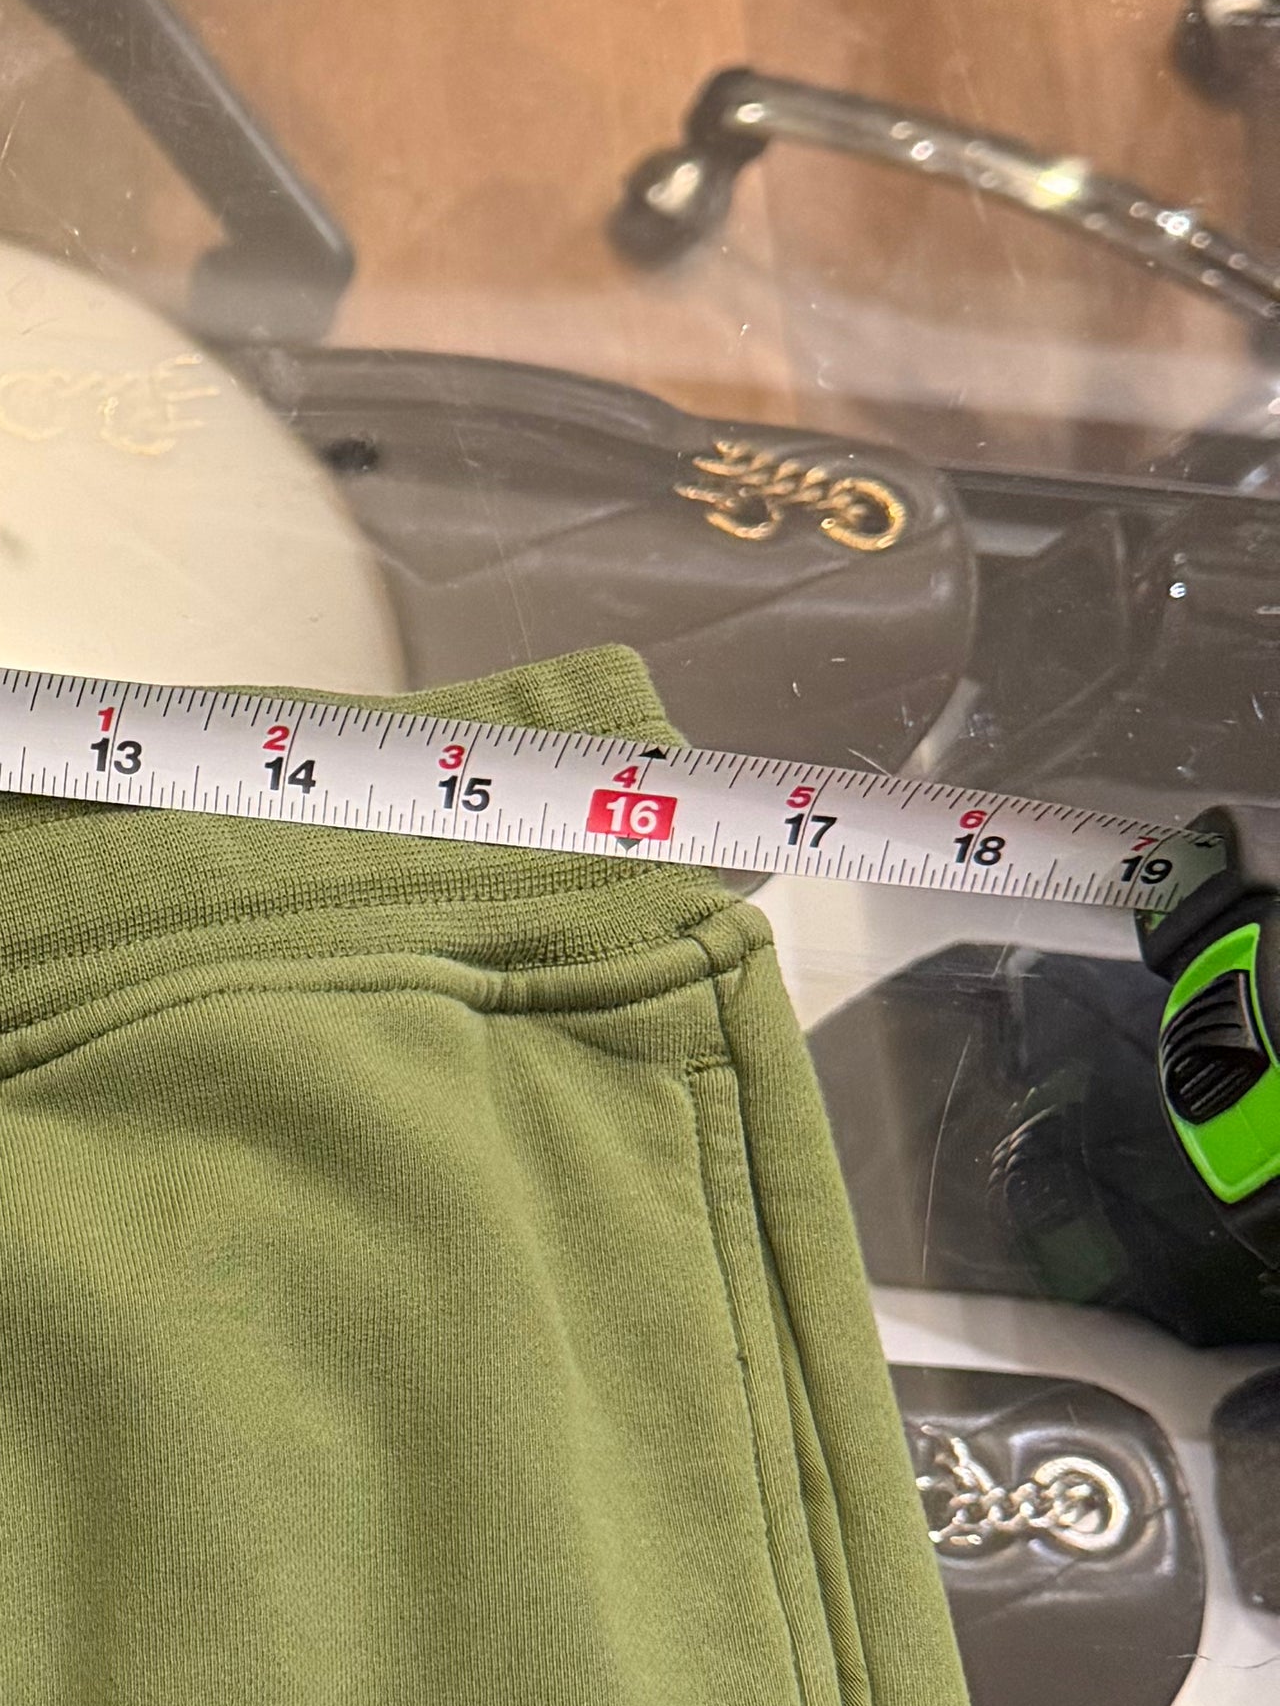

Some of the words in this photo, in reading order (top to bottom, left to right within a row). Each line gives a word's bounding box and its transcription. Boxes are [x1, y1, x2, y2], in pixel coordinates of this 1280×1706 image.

[97, 707, 115, 732] 1
[262, 725, 290, 751] 2
[91, 739, 142, 776] 13
[438, 744, 465, 770] 3
[263, 757, 317, 794] 14
[613, 766, 638, 789] 4
[438, 775, 491, 813] 15
[786, 786, 815, 810] 5
[605, 795, 659, 833] 16
[959, 809, 987, 829] 6
[783, 814, 837, 849] 17
[1130, 835, 1159, 852] 7
[953, 835, 1007, 867] 18
[1120, 854, 1174, 885] 19
